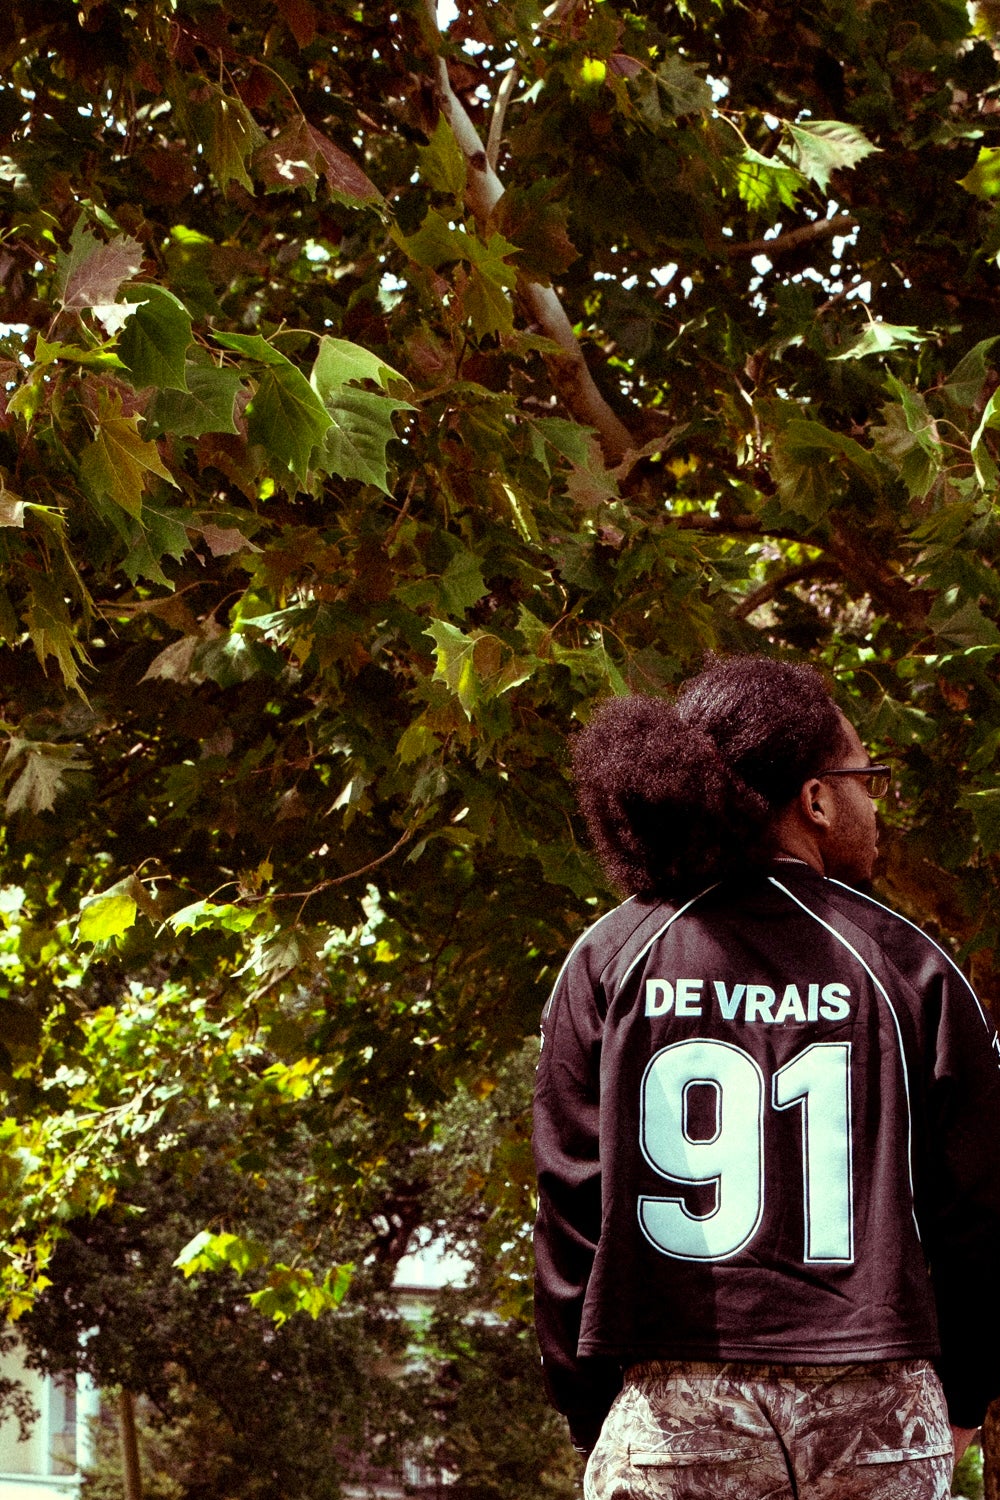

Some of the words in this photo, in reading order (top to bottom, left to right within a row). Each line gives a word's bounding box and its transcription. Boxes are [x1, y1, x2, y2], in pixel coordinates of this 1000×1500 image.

[645, 978, 704, 1018] DE
[712, 980, 851, 1023] VRAIS
[637, 1037, 855, 1265] 91
